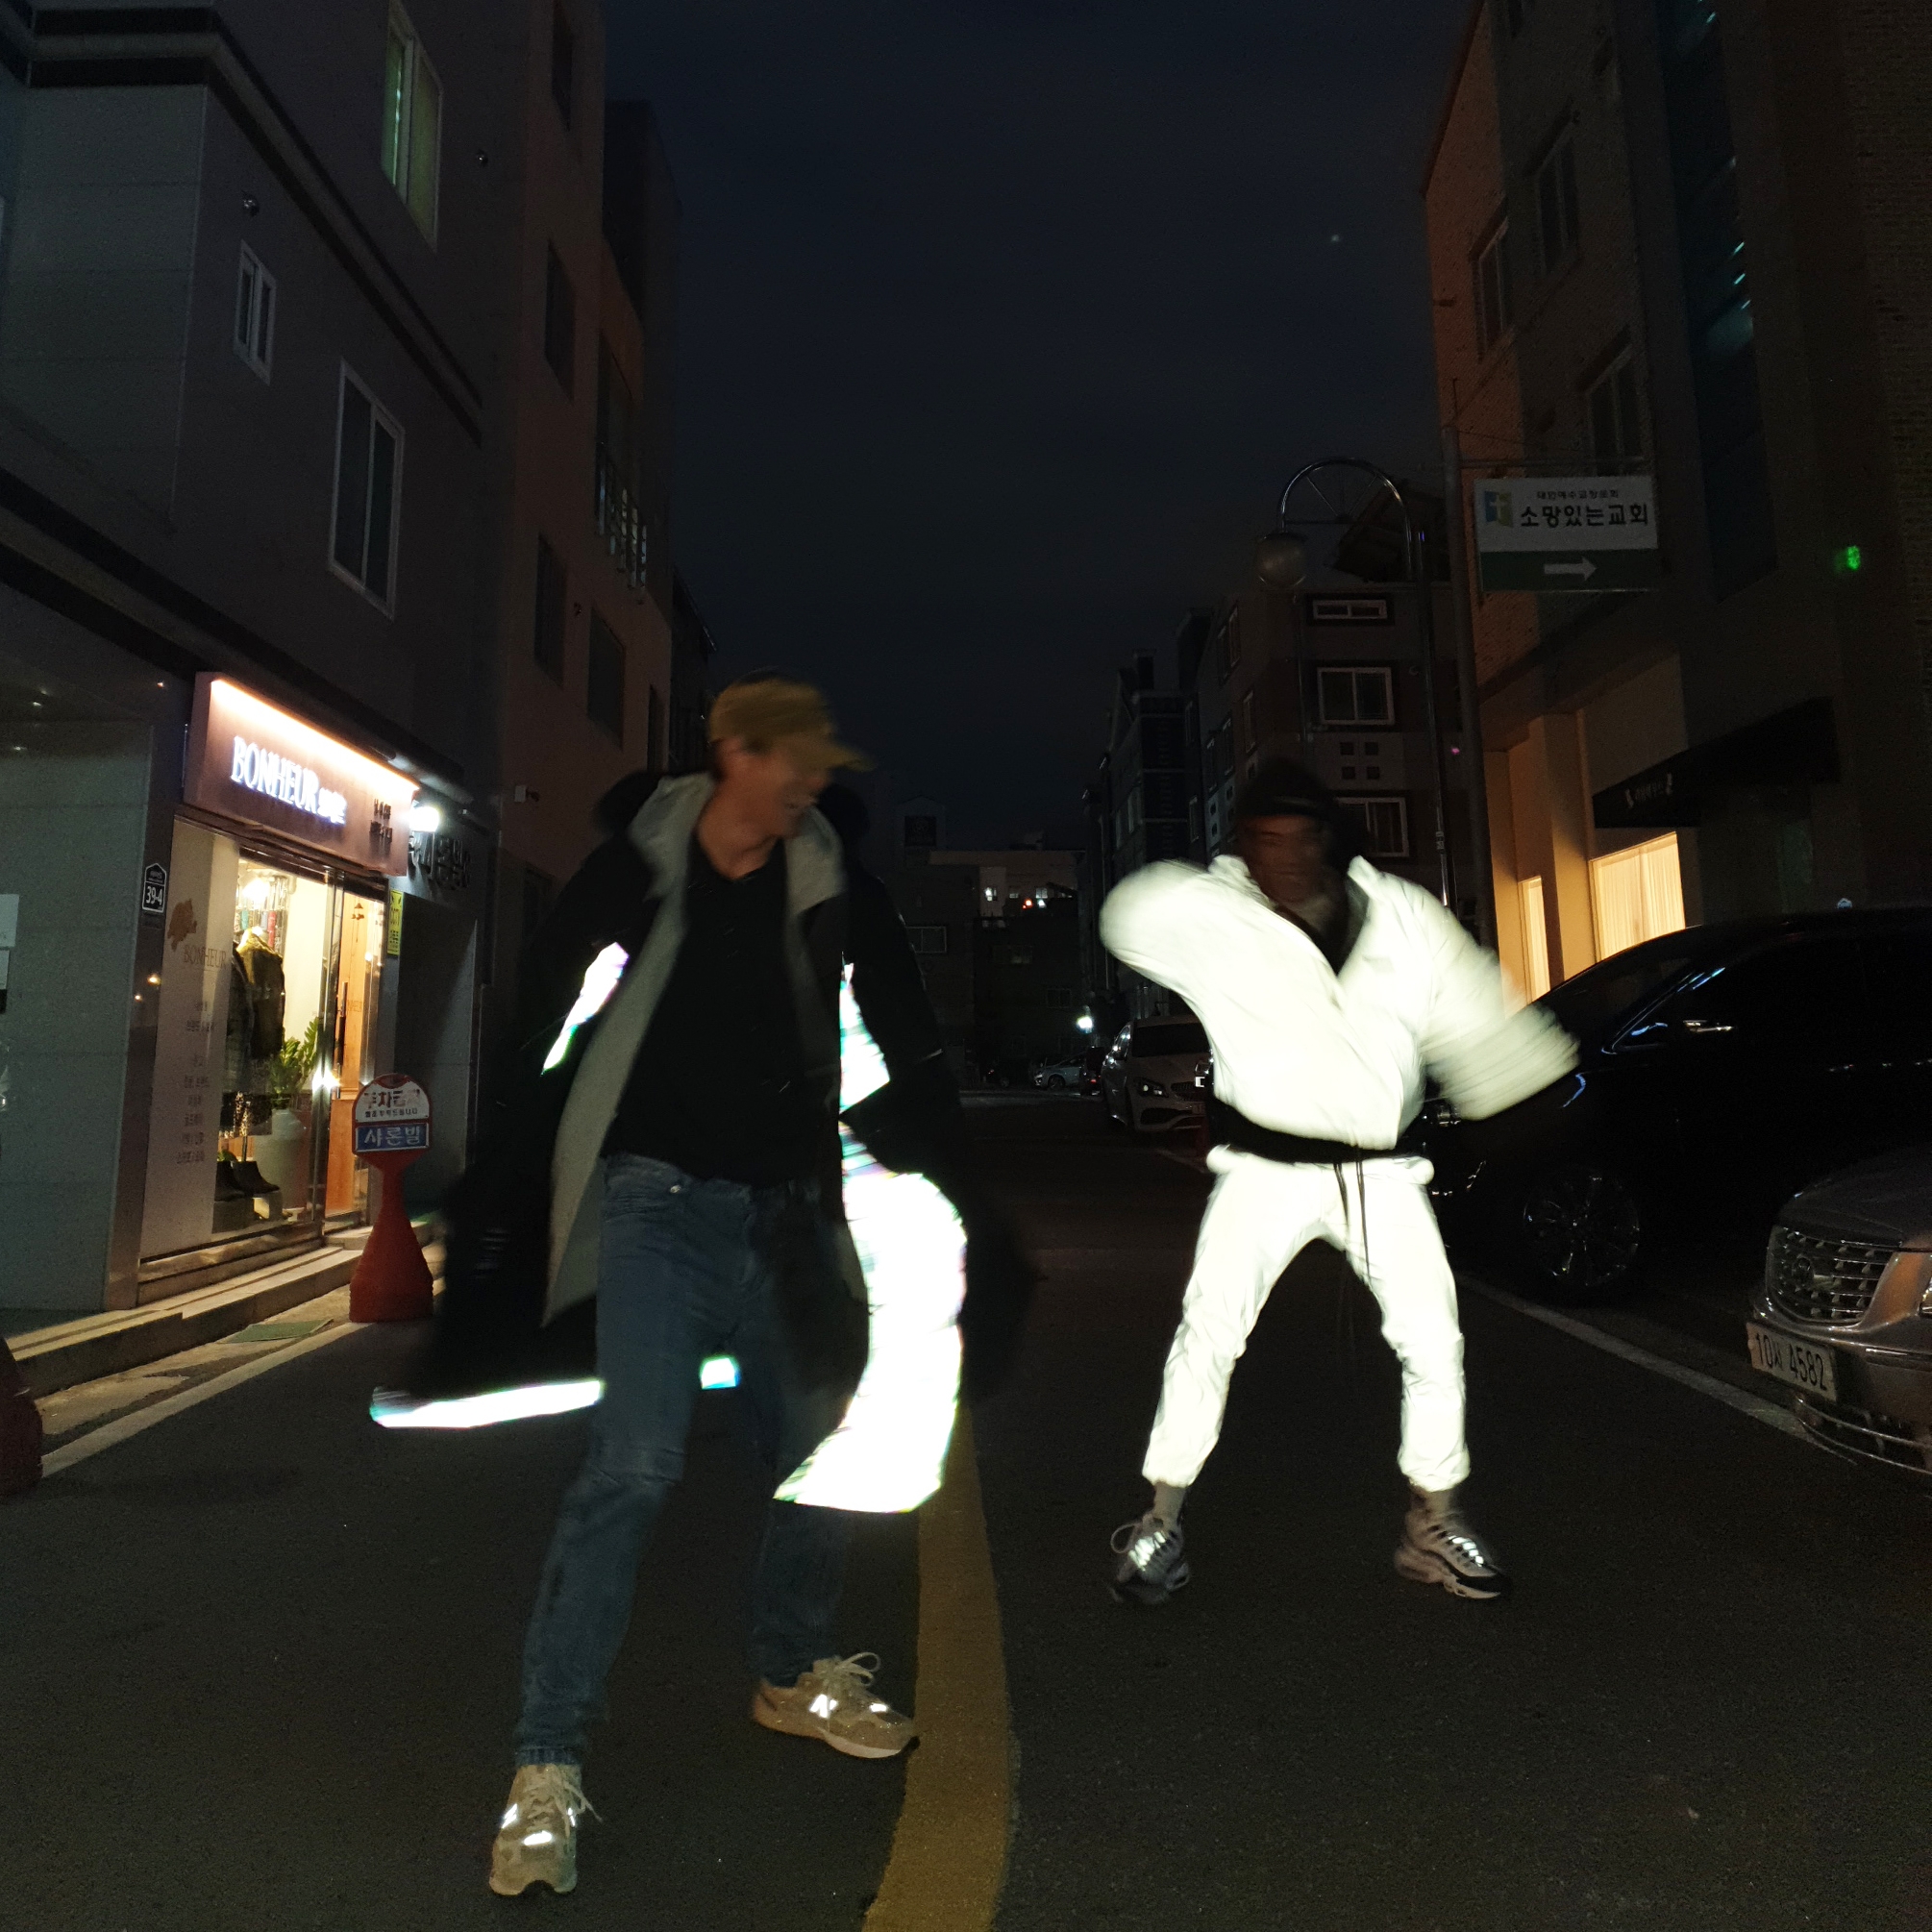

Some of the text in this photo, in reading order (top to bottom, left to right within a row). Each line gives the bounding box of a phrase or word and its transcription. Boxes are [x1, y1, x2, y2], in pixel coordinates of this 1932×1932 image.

[1521, 503, 1647, 528] 소망있는교회
[231, 735, 319, 816] BONHEUR
[146, 885, 162, 905] 39-4
[184, 945, 226, 968] BONHEUR
[364, 1126, 420, 1147] 사론빌
[1789, 1344, 1827, 1391] 4582
